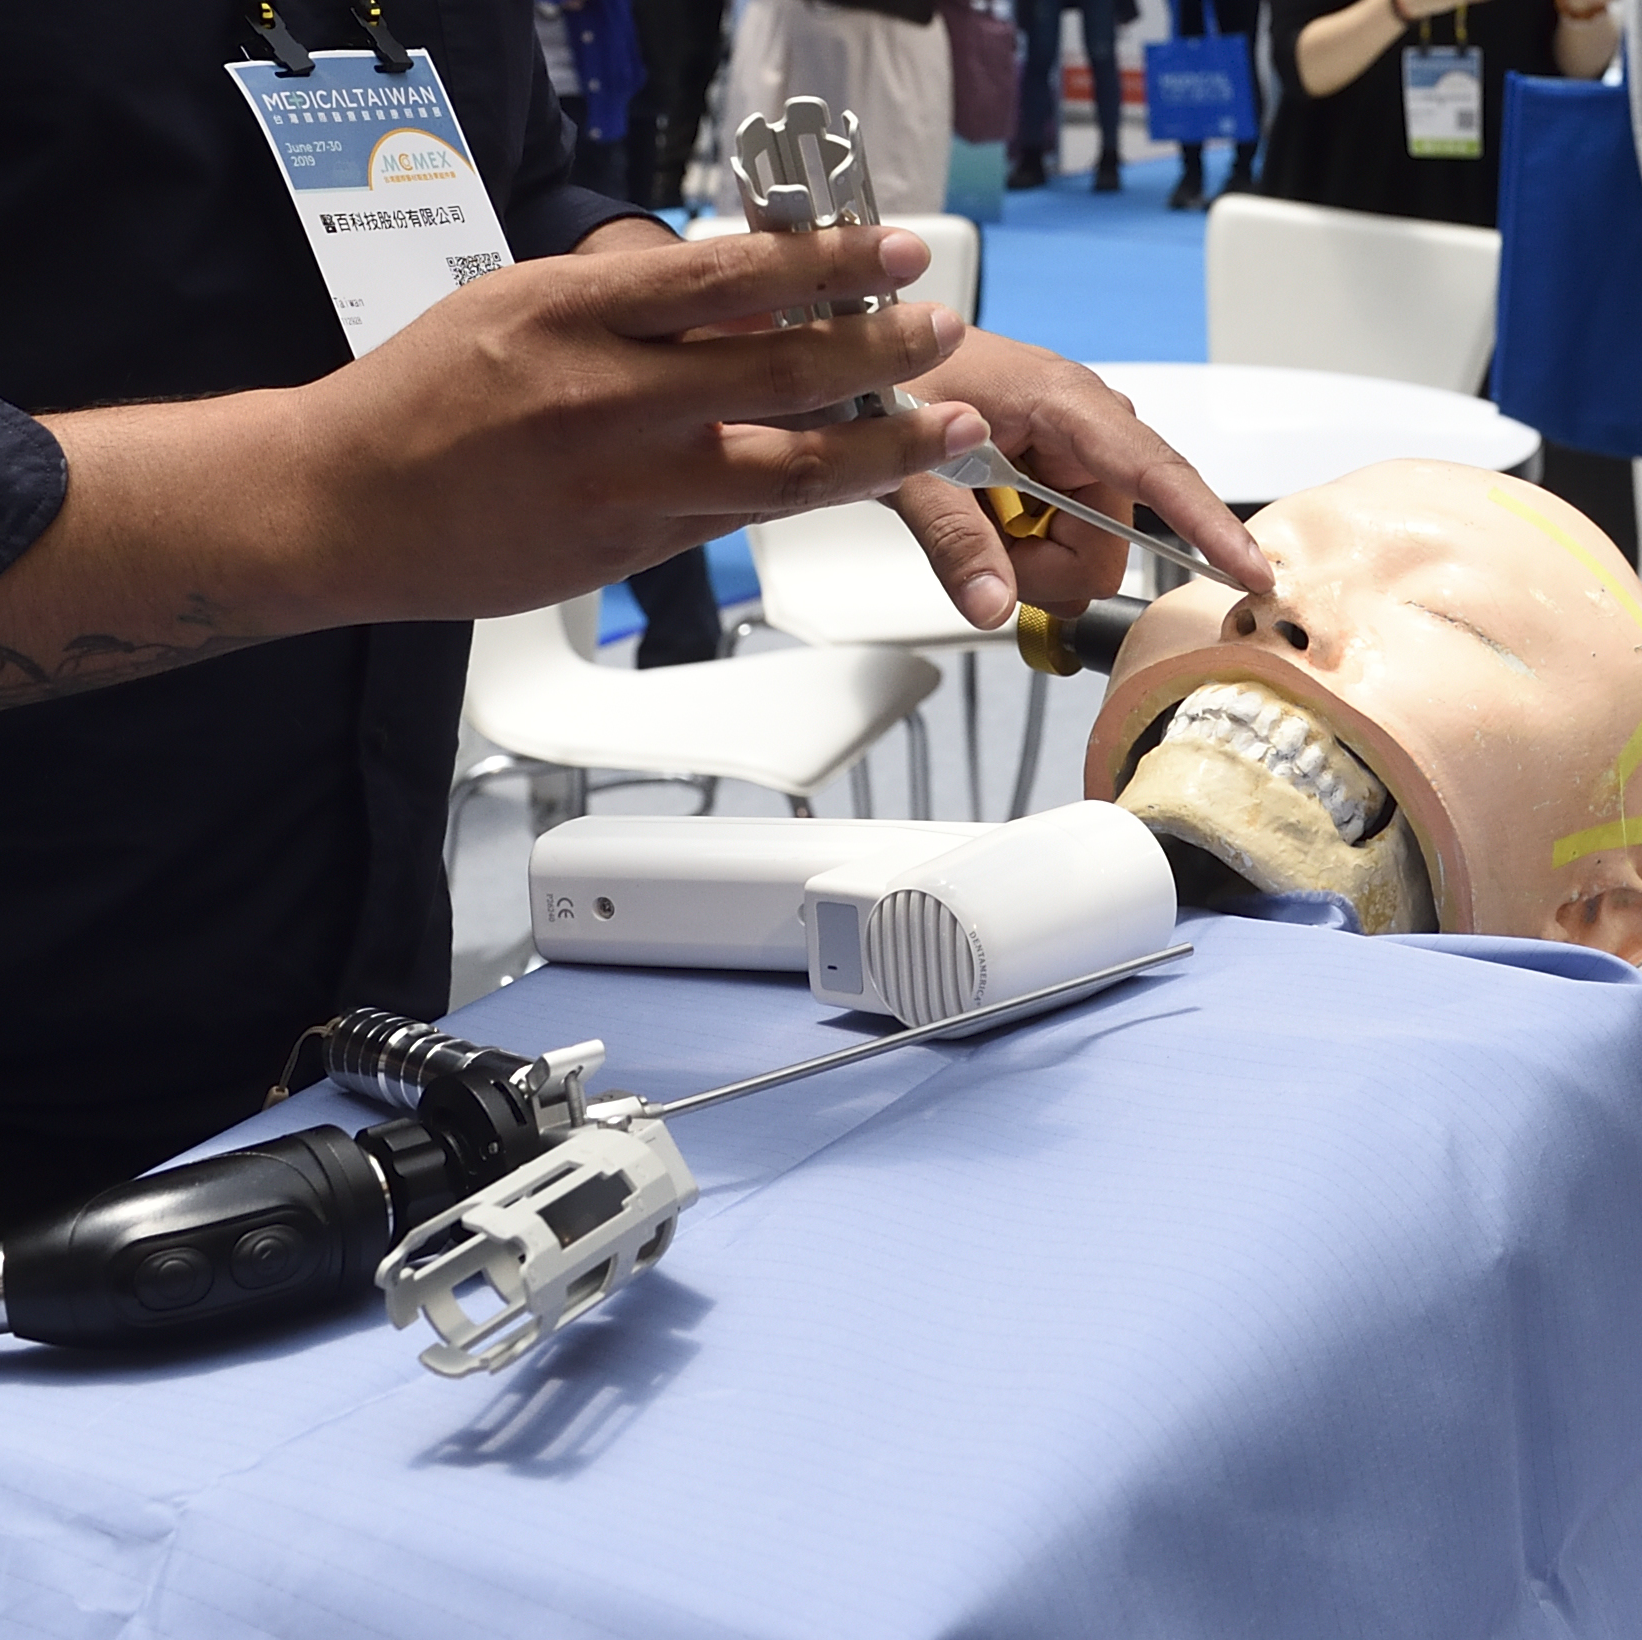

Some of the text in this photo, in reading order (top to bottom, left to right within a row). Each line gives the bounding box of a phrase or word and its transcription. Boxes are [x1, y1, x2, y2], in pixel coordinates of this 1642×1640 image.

[285, 142, 313, 154] June
[291, 154, 316, 167] 2019
[319, 205, 466, 234] 醫百科技股份有限公司
